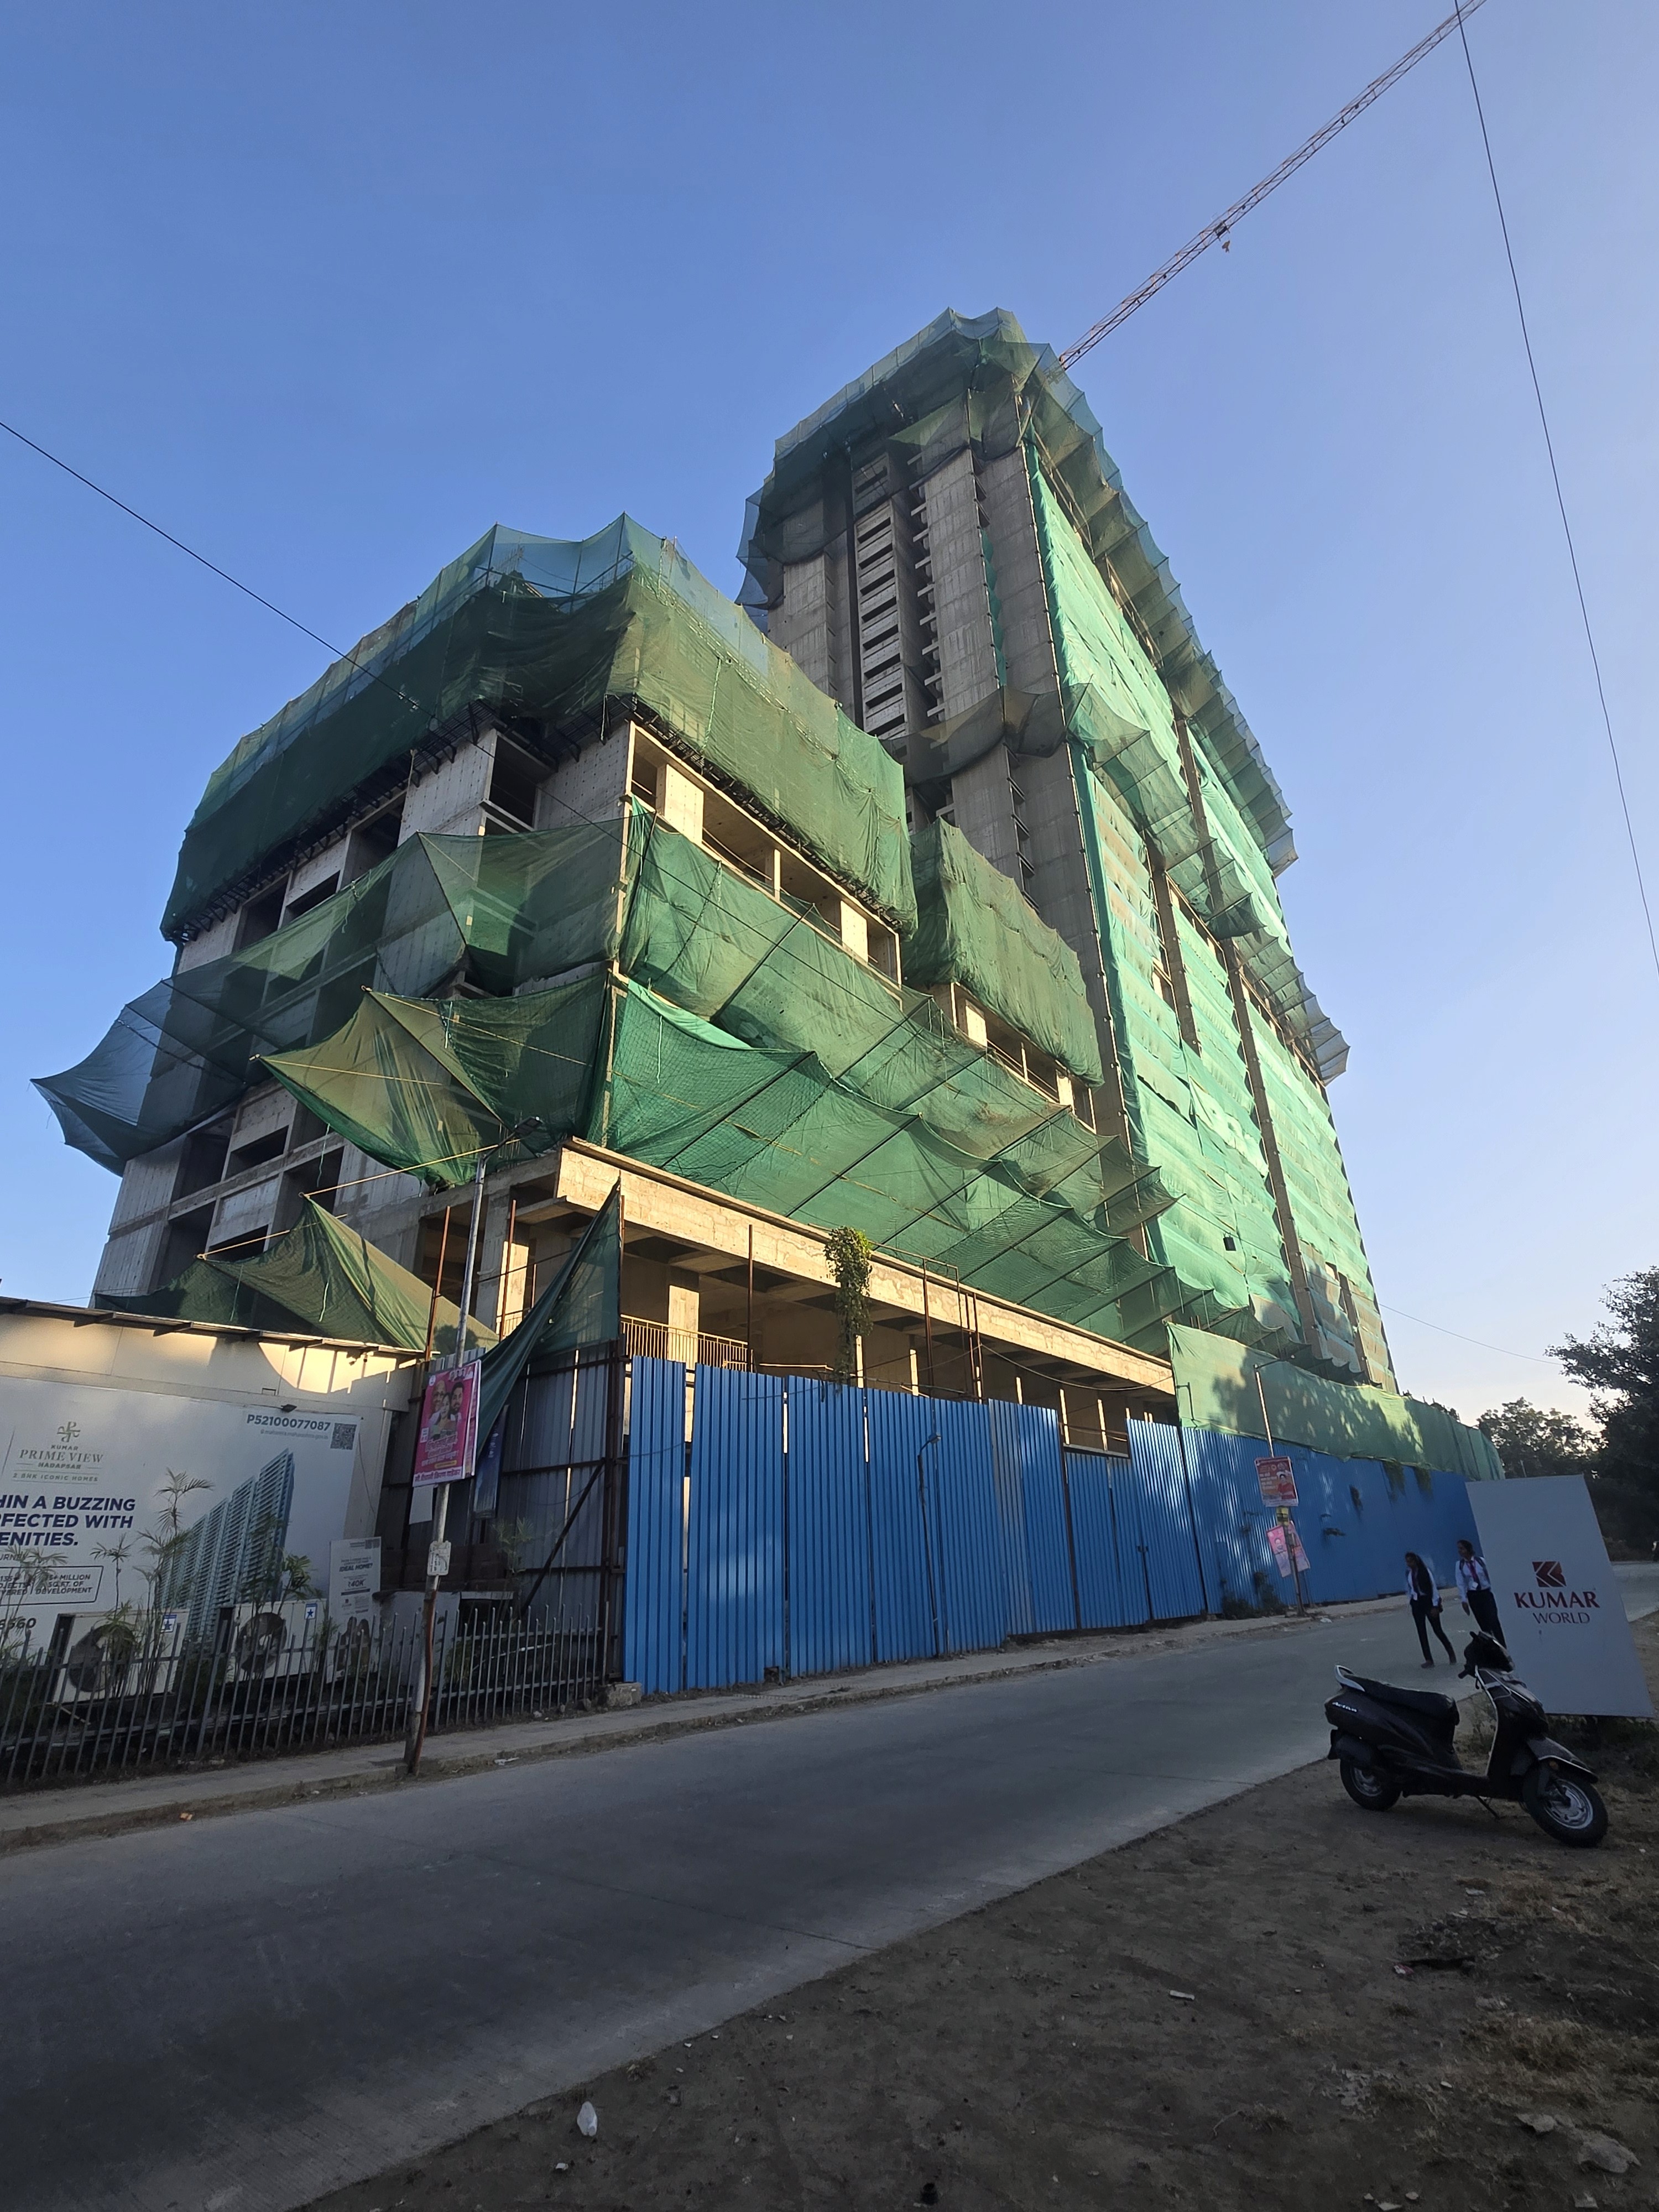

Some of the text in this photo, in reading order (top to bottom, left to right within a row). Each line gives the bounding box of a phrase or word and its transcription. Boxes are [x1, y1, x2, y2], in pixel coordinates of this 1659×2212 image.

[247, 1414, 331, 1431] P52100077087
[19, 1449, 103, 1463] PRIME VIEW
[32, 1495, 46, 1509] A
[53, 1496, 135, 1511] BUZZING
[0, 1513, 133, 1528] FECTED WITH
[1514, 1591, 1600, 1609] KUMAR
[1532, 1612, 1590, 1624] WORLD
